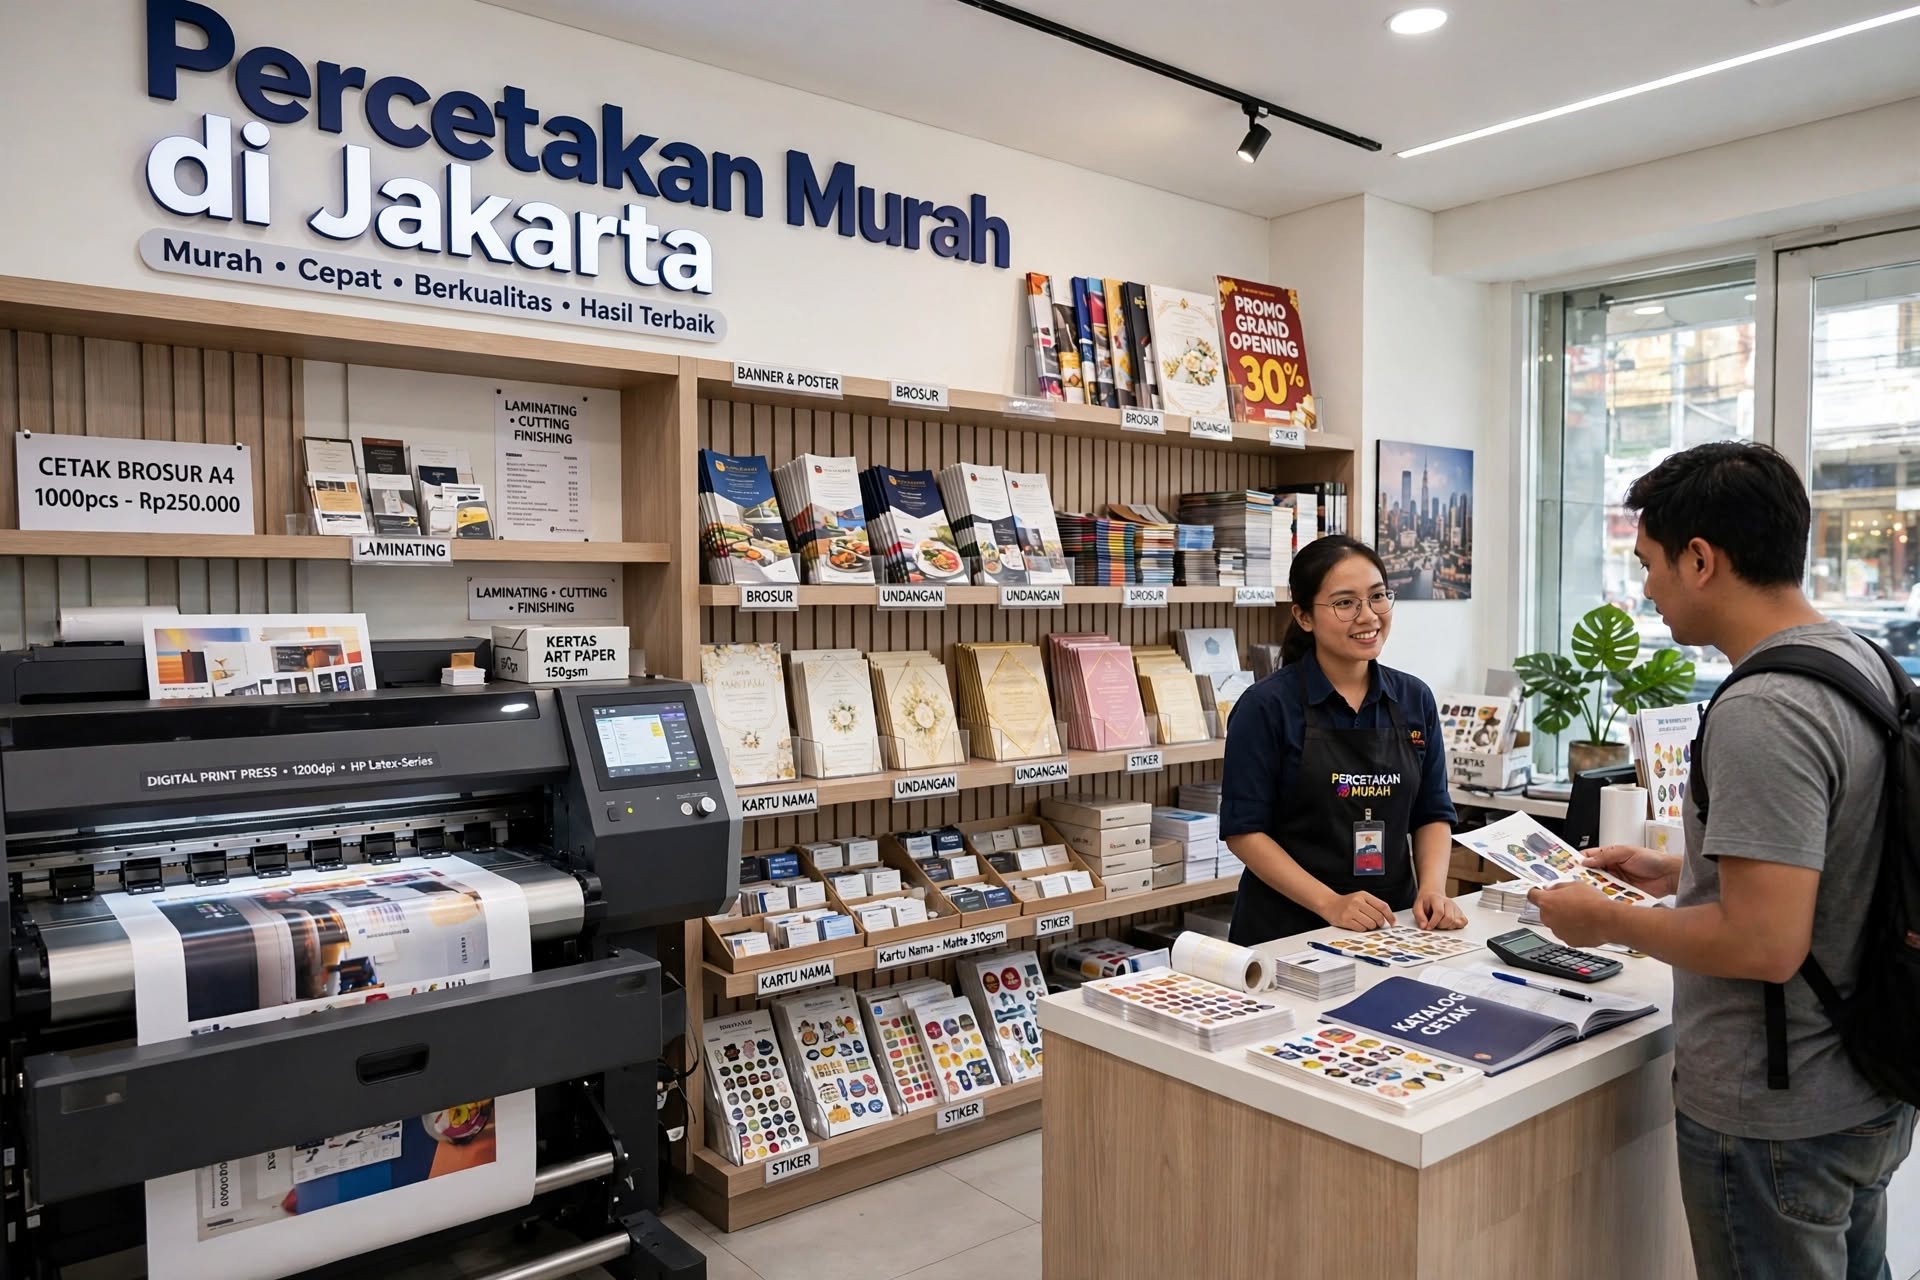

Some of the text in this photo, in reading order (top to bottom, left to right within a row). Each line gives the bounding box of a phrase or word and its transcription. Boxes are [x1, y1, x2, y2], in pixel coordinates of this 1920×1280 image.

[146, 0, 1011, 269] Percetakan Murah
[145, 113, 713, 294] di Jakarta
[162, 237, 716, 335] Murah Cepat Berkualitas Hasil Terbaik
[1234, 295, 1286, 320] PROMO
[1235, 313, 1290, 338] GRAND
[1229, 331, 1299, 358] OPENING
[737, 366, 839, 390] BANNER & POSTER
[1239, 355, 1304, 405] 30%
[896, 385, 939, 402] BROSUR
[505, 399, 577, 417] LAMINATING
[518, 415, 570, 430] CUTTING
[1126, 413, 1159, 427] BROSUR
[514, 430, 573, 444] FINISHING
[38, 456, 235, 485] CETAK BROSUR A4
[34, 487, 119, 512] 1000pcs
[139, 491, 241, 514] Rp250.000
[359, 541, 446, 558] LAMINATING
[476, 586, 607, 598] LAMINATING CUTTING
[746, 590, 793, 603] BROSUR
[882, 590, 943, 602] UNDANGAN
[1006, 590, 1060, 601] UNDANGAN
[518, 602, 575, 613] FINISHING
[546, 635, 597, 648] KERTAS
[544, 649, 616, 663] ART PAPER
[545, 666, 588, 680] 150gsm
[1131, 755, 1159, 767] STIKER
[147, 772, 198, 787] DIGITAL
[200, 769, 237, 783] PRINT
[240, 767, 278, 780] PRESS
[292, 762, 335, 776] 1200dpi
[350, 761, 366, 772] HP
[1016, 764, 1067, 780] UNDANGAN
[1331, 773, 1401, 785] PERCETAKAN
[897, 776, 955, 794] UNDANGAN
[1351, 786, 1391, 797] MURAH
[742, 792, 815, 812] KARTU NAMA
[1040, 915, 1070, 931] STIKER
[879, 948, 906, 964] Kartu
[908, 944, 933, 956] Nama
[942, 936, 968, 950] Matte
[970, 930, 1004, 945] 310gsm
[761, 963, 831, 989] KARTU NAMA
[1391, 991, 1469, 1033] KATALOG
[1420, 1004, 1478, 1037] CETAK
[945, 1103, 979, 1124] STIKER
[772, 1153, 812, 1175] STIKER
